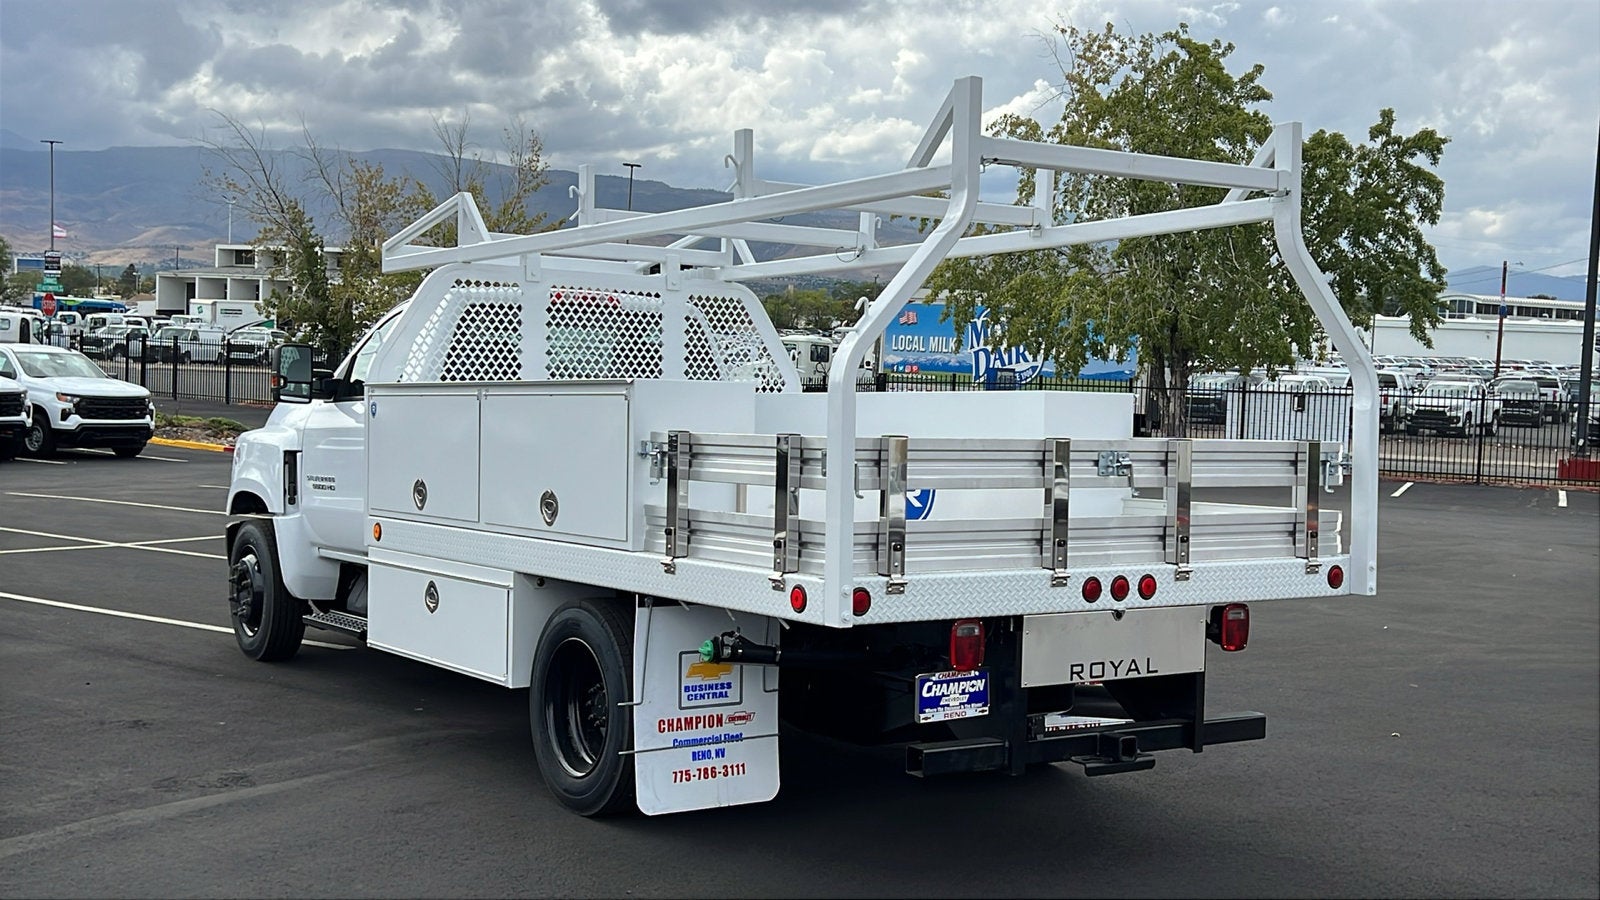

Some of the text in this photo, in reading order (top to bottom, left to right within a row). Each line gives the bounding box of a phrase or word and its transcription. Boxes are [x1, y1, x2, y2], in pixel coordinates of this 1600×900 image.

[43, 300, 57, 309] STOP
[892, 334, 957, 353] LOCAL MILK
[1069, 657, 1159, 681] ROYAL
[684, 682, 732, 692] BUSINESS
[922, 679, 986, 697] CHAMPION
[687, 691, 729, 701] CENTRAL
[658, 713, 723, 733] CHAMPION
[944, 711, 967, 719] RENO
[673, 732, 744, 748] Commercial Fleet
[692, 748, 726, 761] RENO, NV
[673, 763, 746, 783] 775-786-3111
